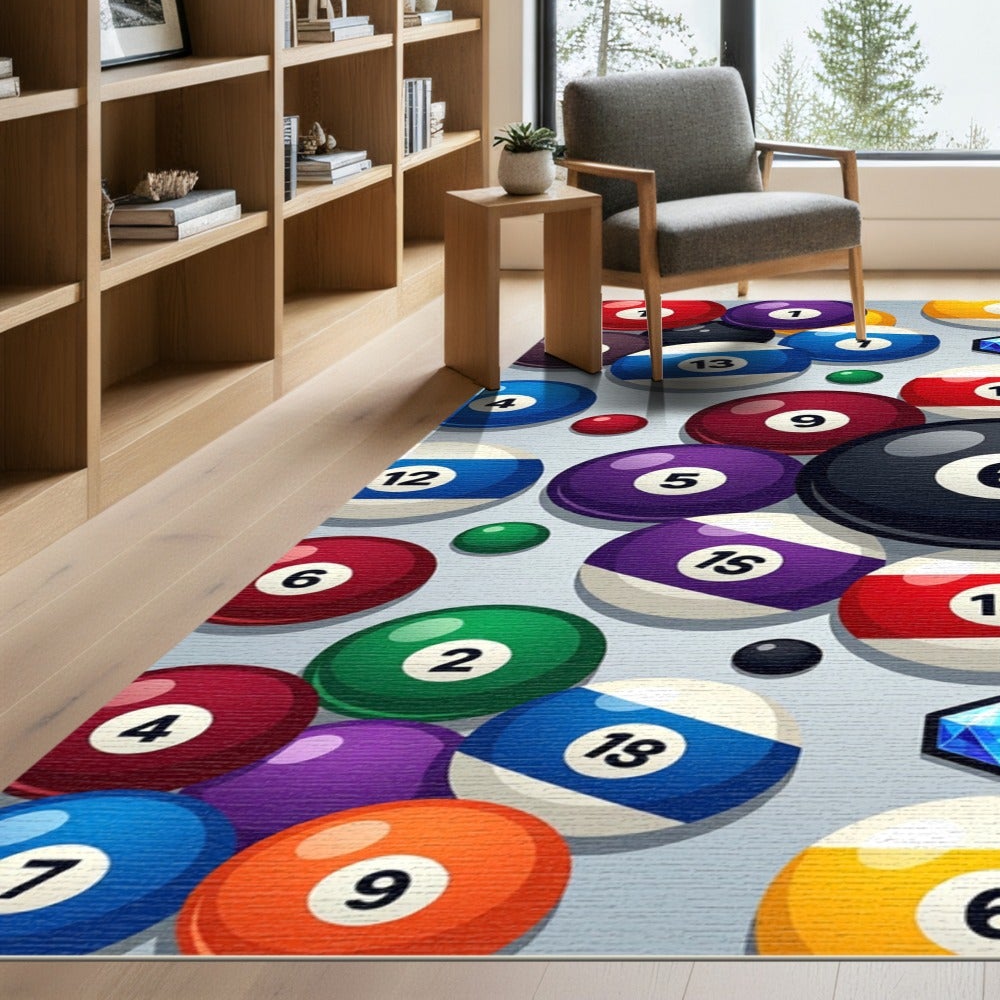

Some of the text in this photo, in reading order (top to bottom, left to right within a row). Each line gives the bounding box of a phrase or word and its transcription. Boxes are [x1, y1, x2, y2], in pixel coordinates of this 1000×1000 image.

[690, 359, 735, 370] 13
[484, 398, 517, 409] 4
[790, 414, 826, 428] 9
[382, 470, 440, 486] 12
[659, 472, 700, 490] 5
[281, 569, 328, 589] 6
[428, 647, 483, 673] 2
[117, 714, 181, 743] 4
[0, 859, 82, 900] 7
[344, 869, 412, 911] 9
